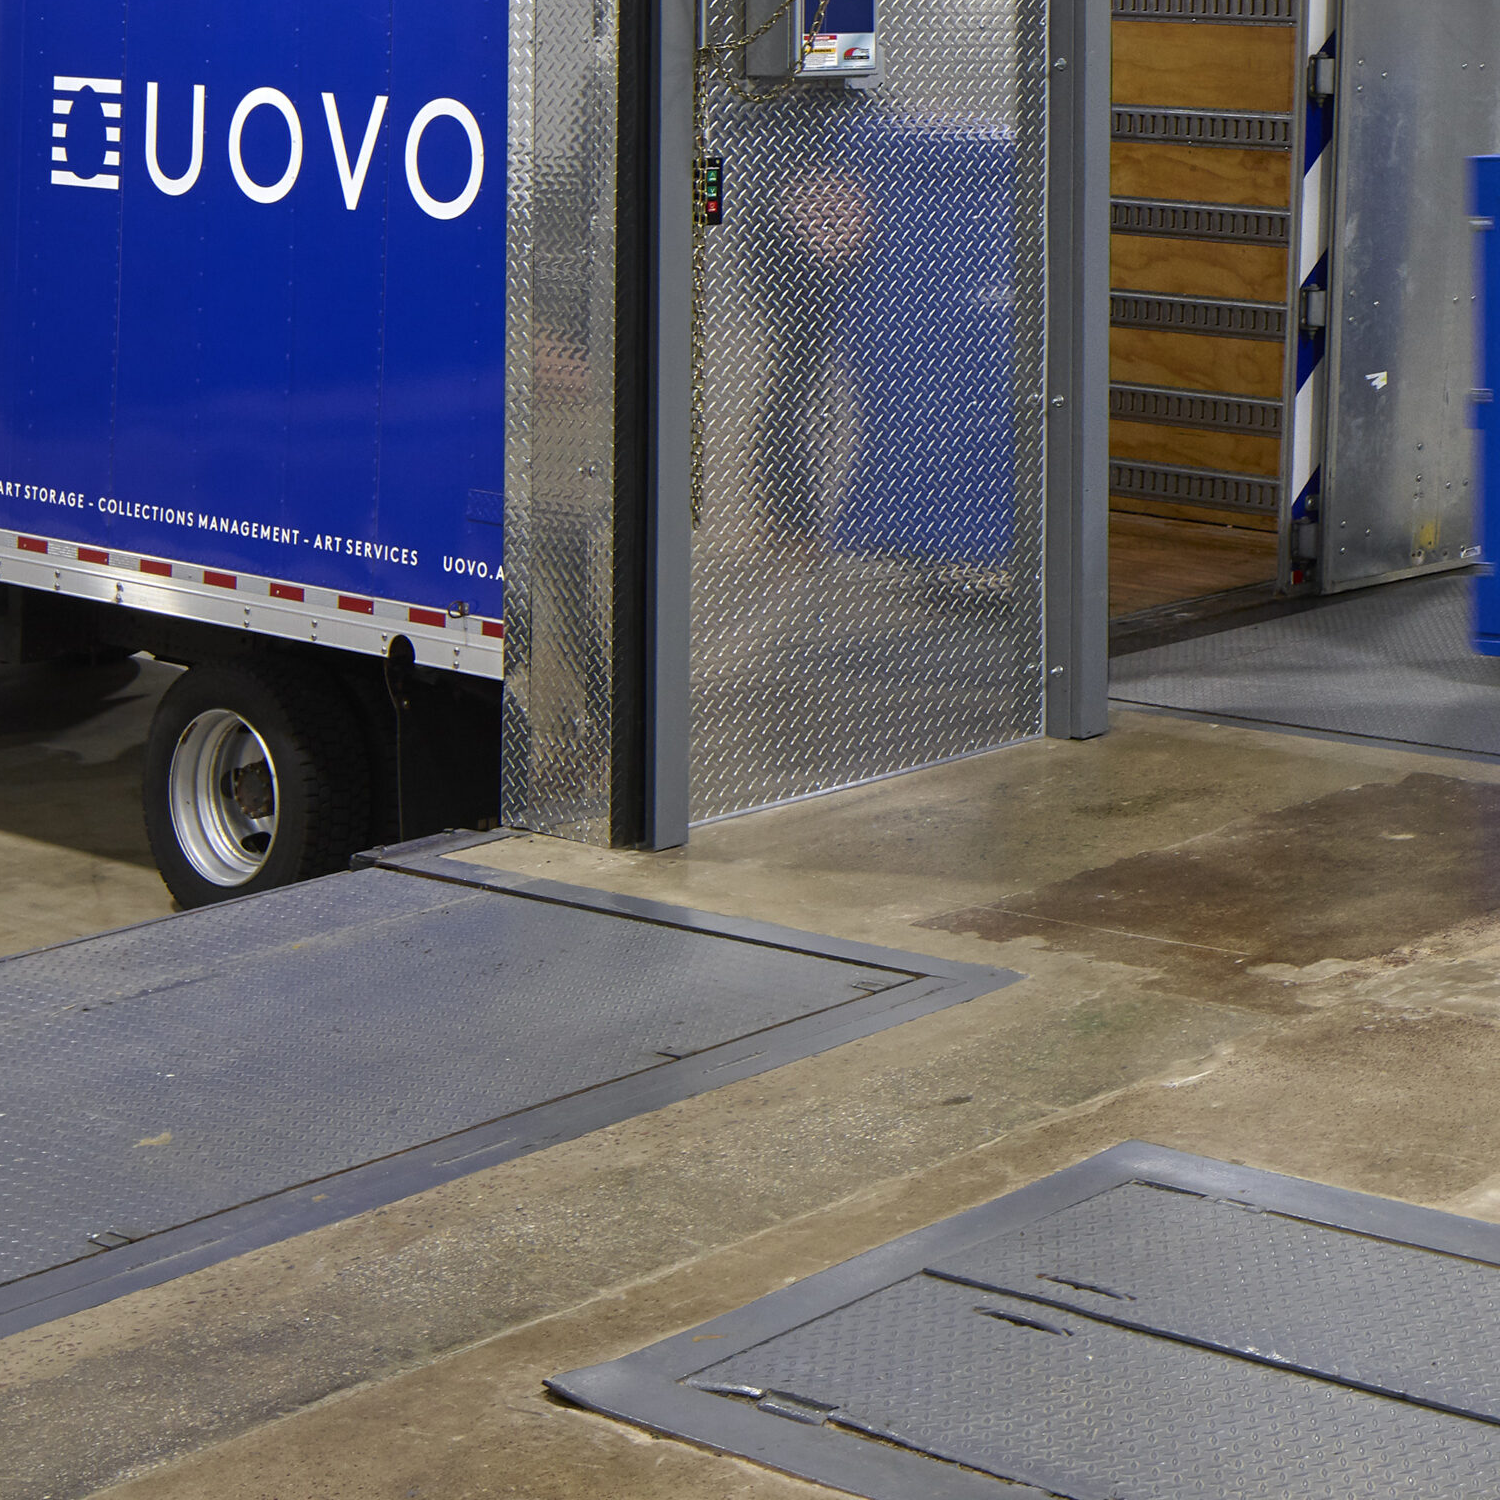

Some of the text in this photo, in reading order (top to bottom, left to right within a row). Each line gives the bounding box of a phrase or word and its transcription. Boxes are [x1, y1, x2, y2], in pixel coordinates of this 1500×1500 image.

[145, 82, 484, 220] UOVO
[24, 484, 85, 509] STORAGE
[98, 496, 194, 528] COLLECTIONS
[198, 513, 300, 546] MANAGEMENT
[313, 533, 343, 553] ART
[345, 538, 419, 567] SERVICES
